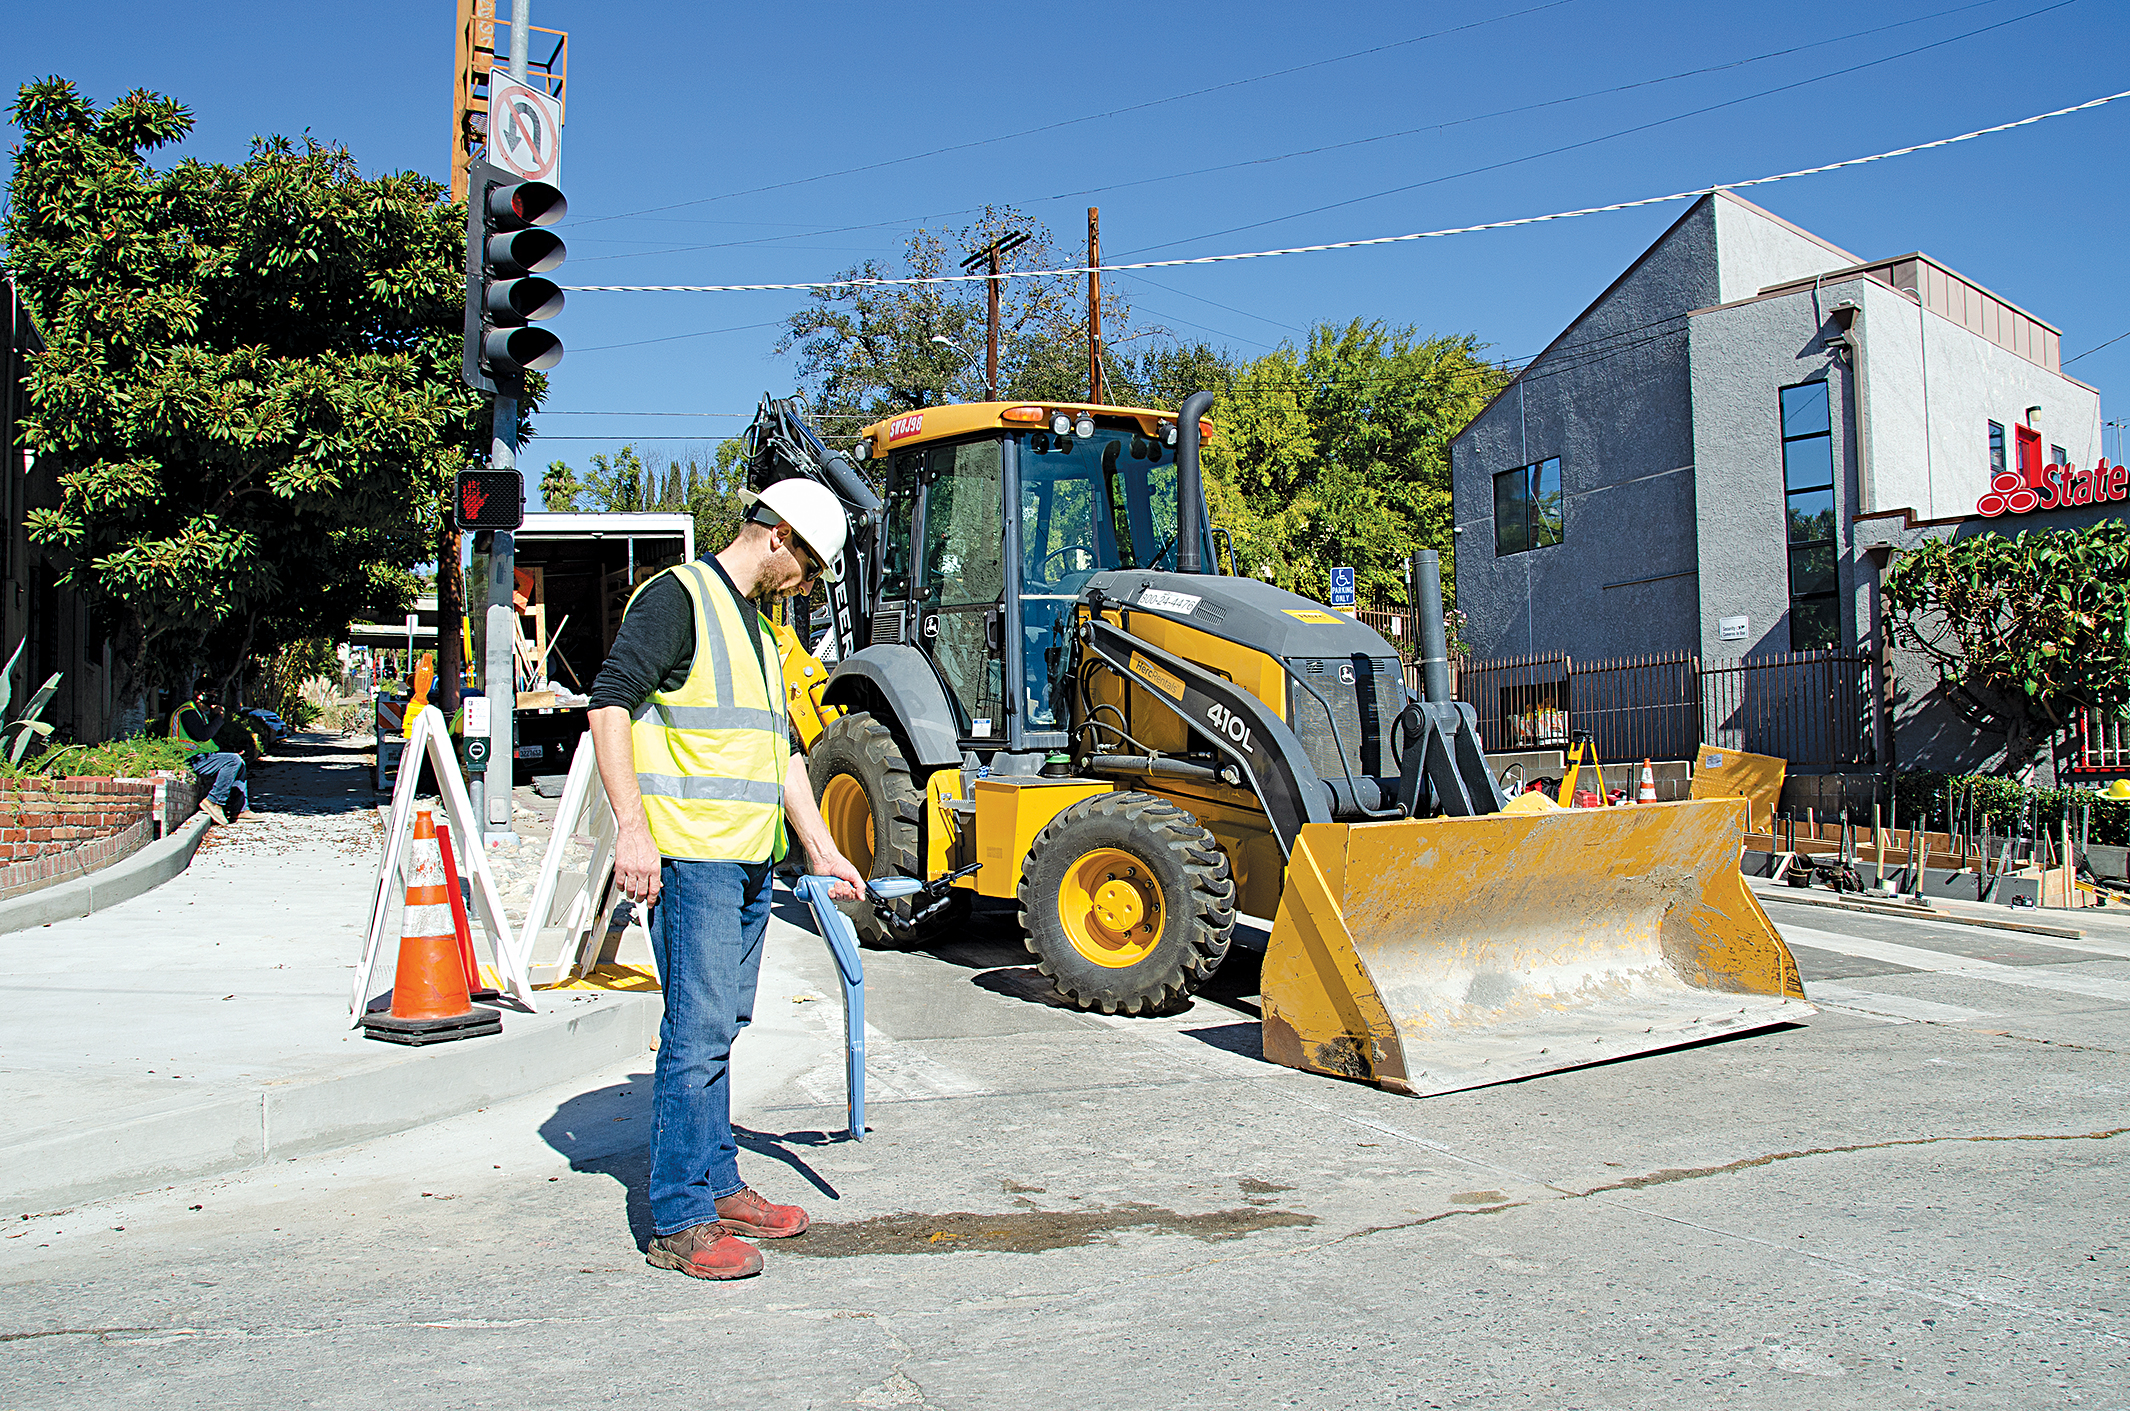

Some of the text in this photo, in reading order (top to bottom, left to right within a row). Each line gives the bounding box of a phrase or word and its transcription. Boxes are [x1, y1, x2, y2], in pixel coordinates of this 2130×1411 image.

[2040, 457, 2128, 509] State
[1331, 586, 1353, 594] PARKING
[1335, 594, 1350, 602] ONLY
[1140, 593, 1196, 611] 800-24-4476
[1206, 702, 1254, 754] 410L
